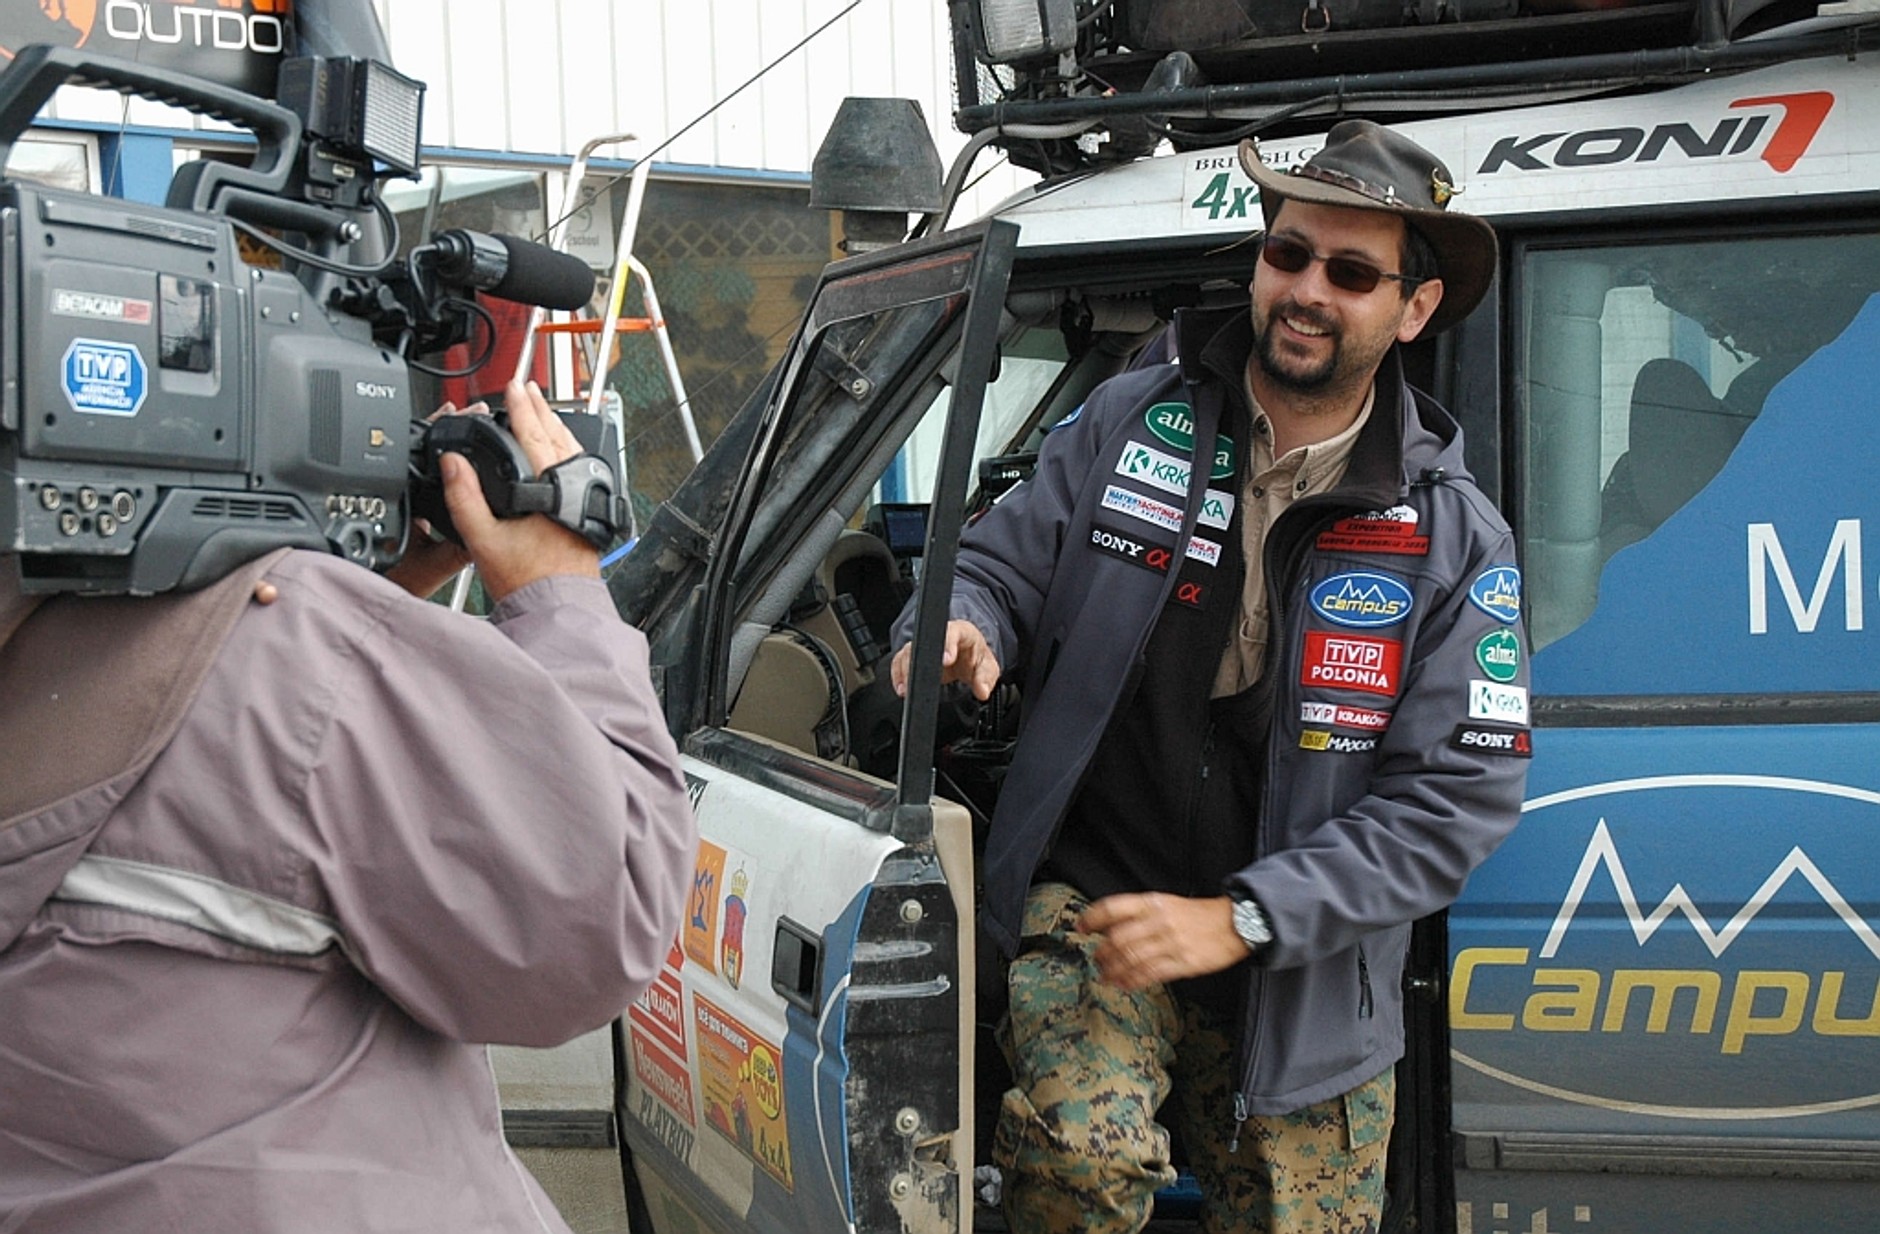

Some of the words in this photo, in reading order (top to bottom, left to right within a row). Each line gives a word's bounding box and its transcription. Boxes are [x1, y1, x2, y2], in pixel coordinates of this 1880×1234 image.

[1477, 114, 1771, 175] KONI
[78, 351, 128, 382] TVP
[356, 382, 397, 399] SONY
[1002, 470, 1020, 479] HD
[1152, 460, 1191, 488] KRK
[1092, 530, 1144, 557] SONY
[1747, 518, 1864, 634] M
[1328, 643, 1378, 665] TVP
[1311, 665, 1389, 688] POLONIA
[1460, 731, 1514, 749] SONY
[1449, 946, 1880, 1055] Campu
[640, 1088, 695, 1167] PLAYBOY
